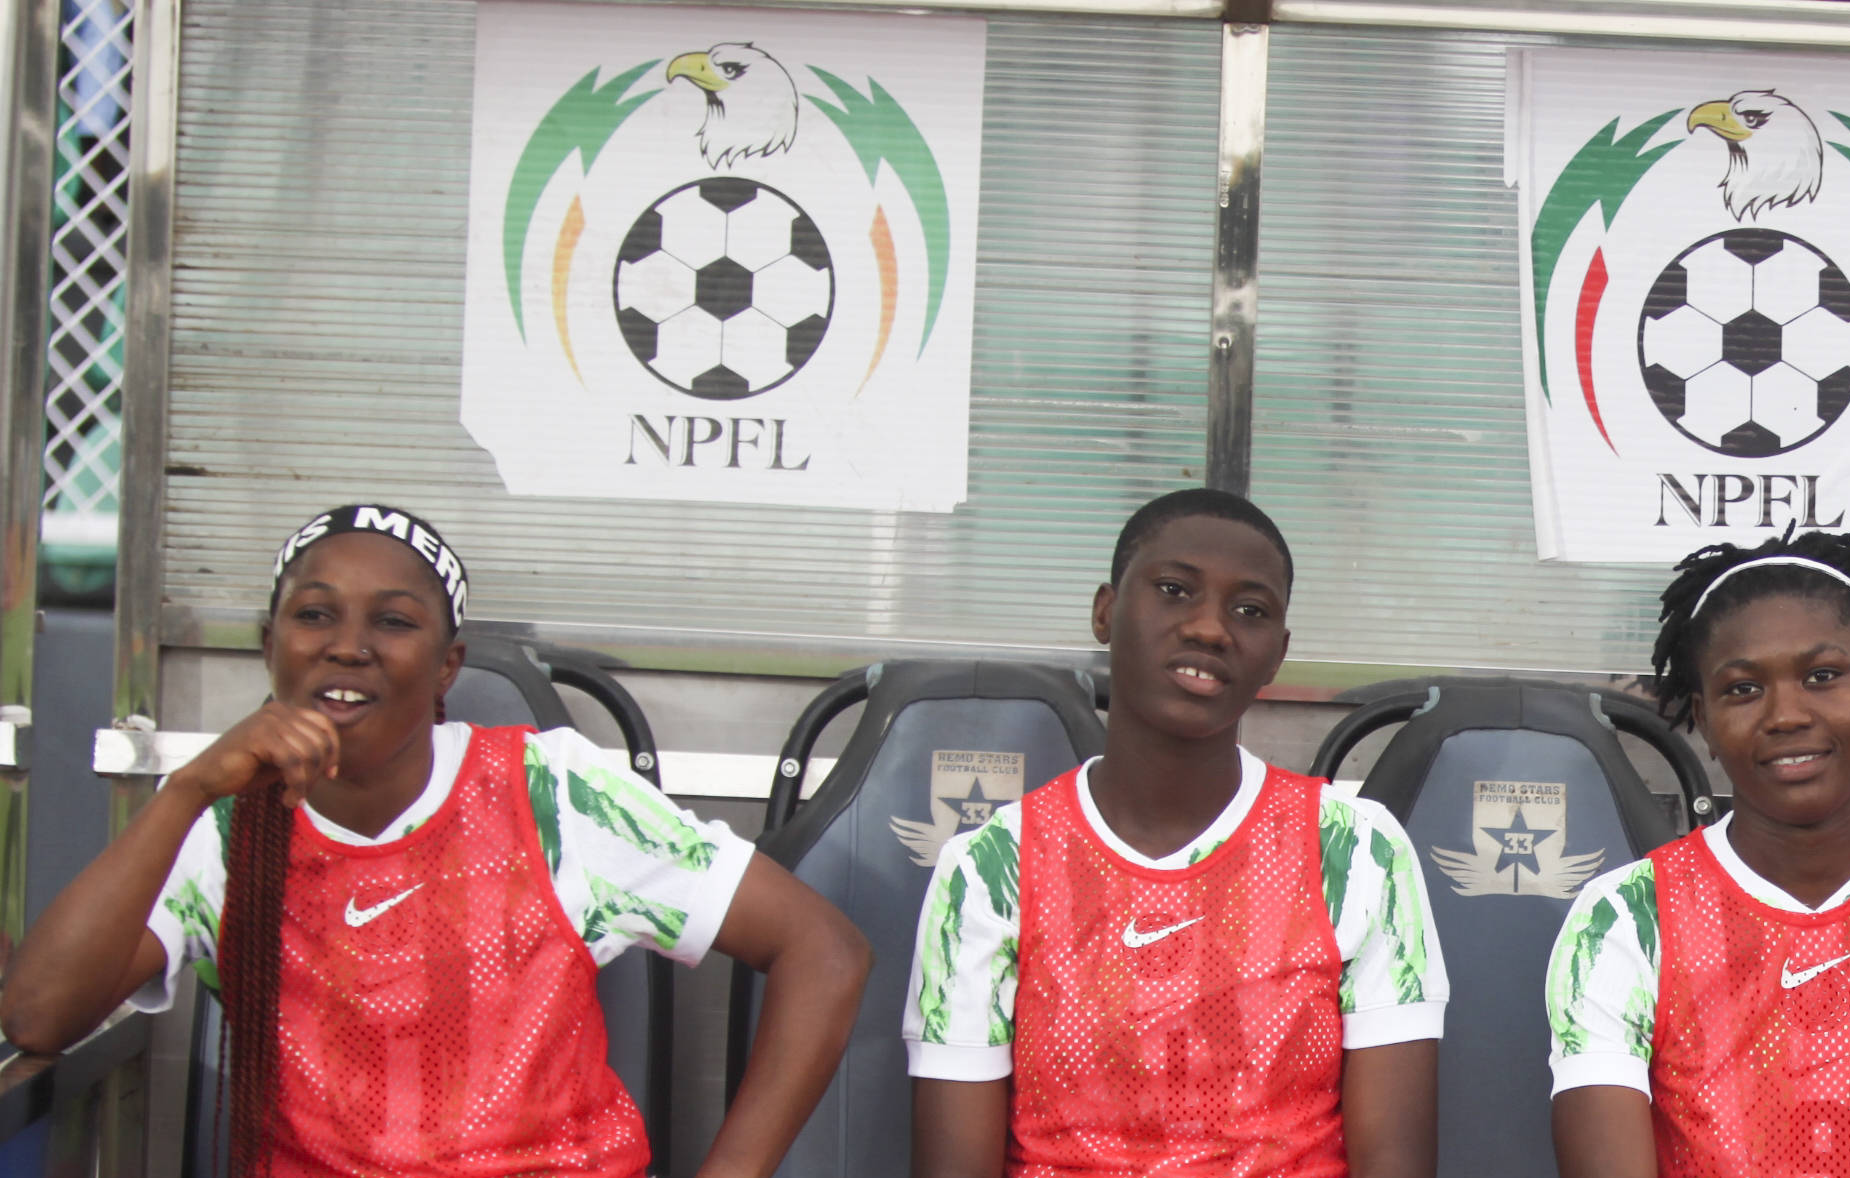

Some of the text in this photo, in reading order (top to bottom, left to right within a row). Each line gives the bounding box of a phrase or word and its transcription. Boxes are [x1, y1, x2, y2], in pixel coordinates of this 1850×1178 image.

[623, 413, 812, 471] NPFL
[1653, 472, 1846, 528] NPFL
[937, 752, 1019, 765] REMO STARS
[937, 764, 1019, 775] FOOTBALL CLUB
[1519, 784, 1560, 796] STARS
[1479, 794, 1561, 805] FOOTBALL CLUB
[961, 802, 993, 825] 33
[1504, 832, 1535, 855] 33
